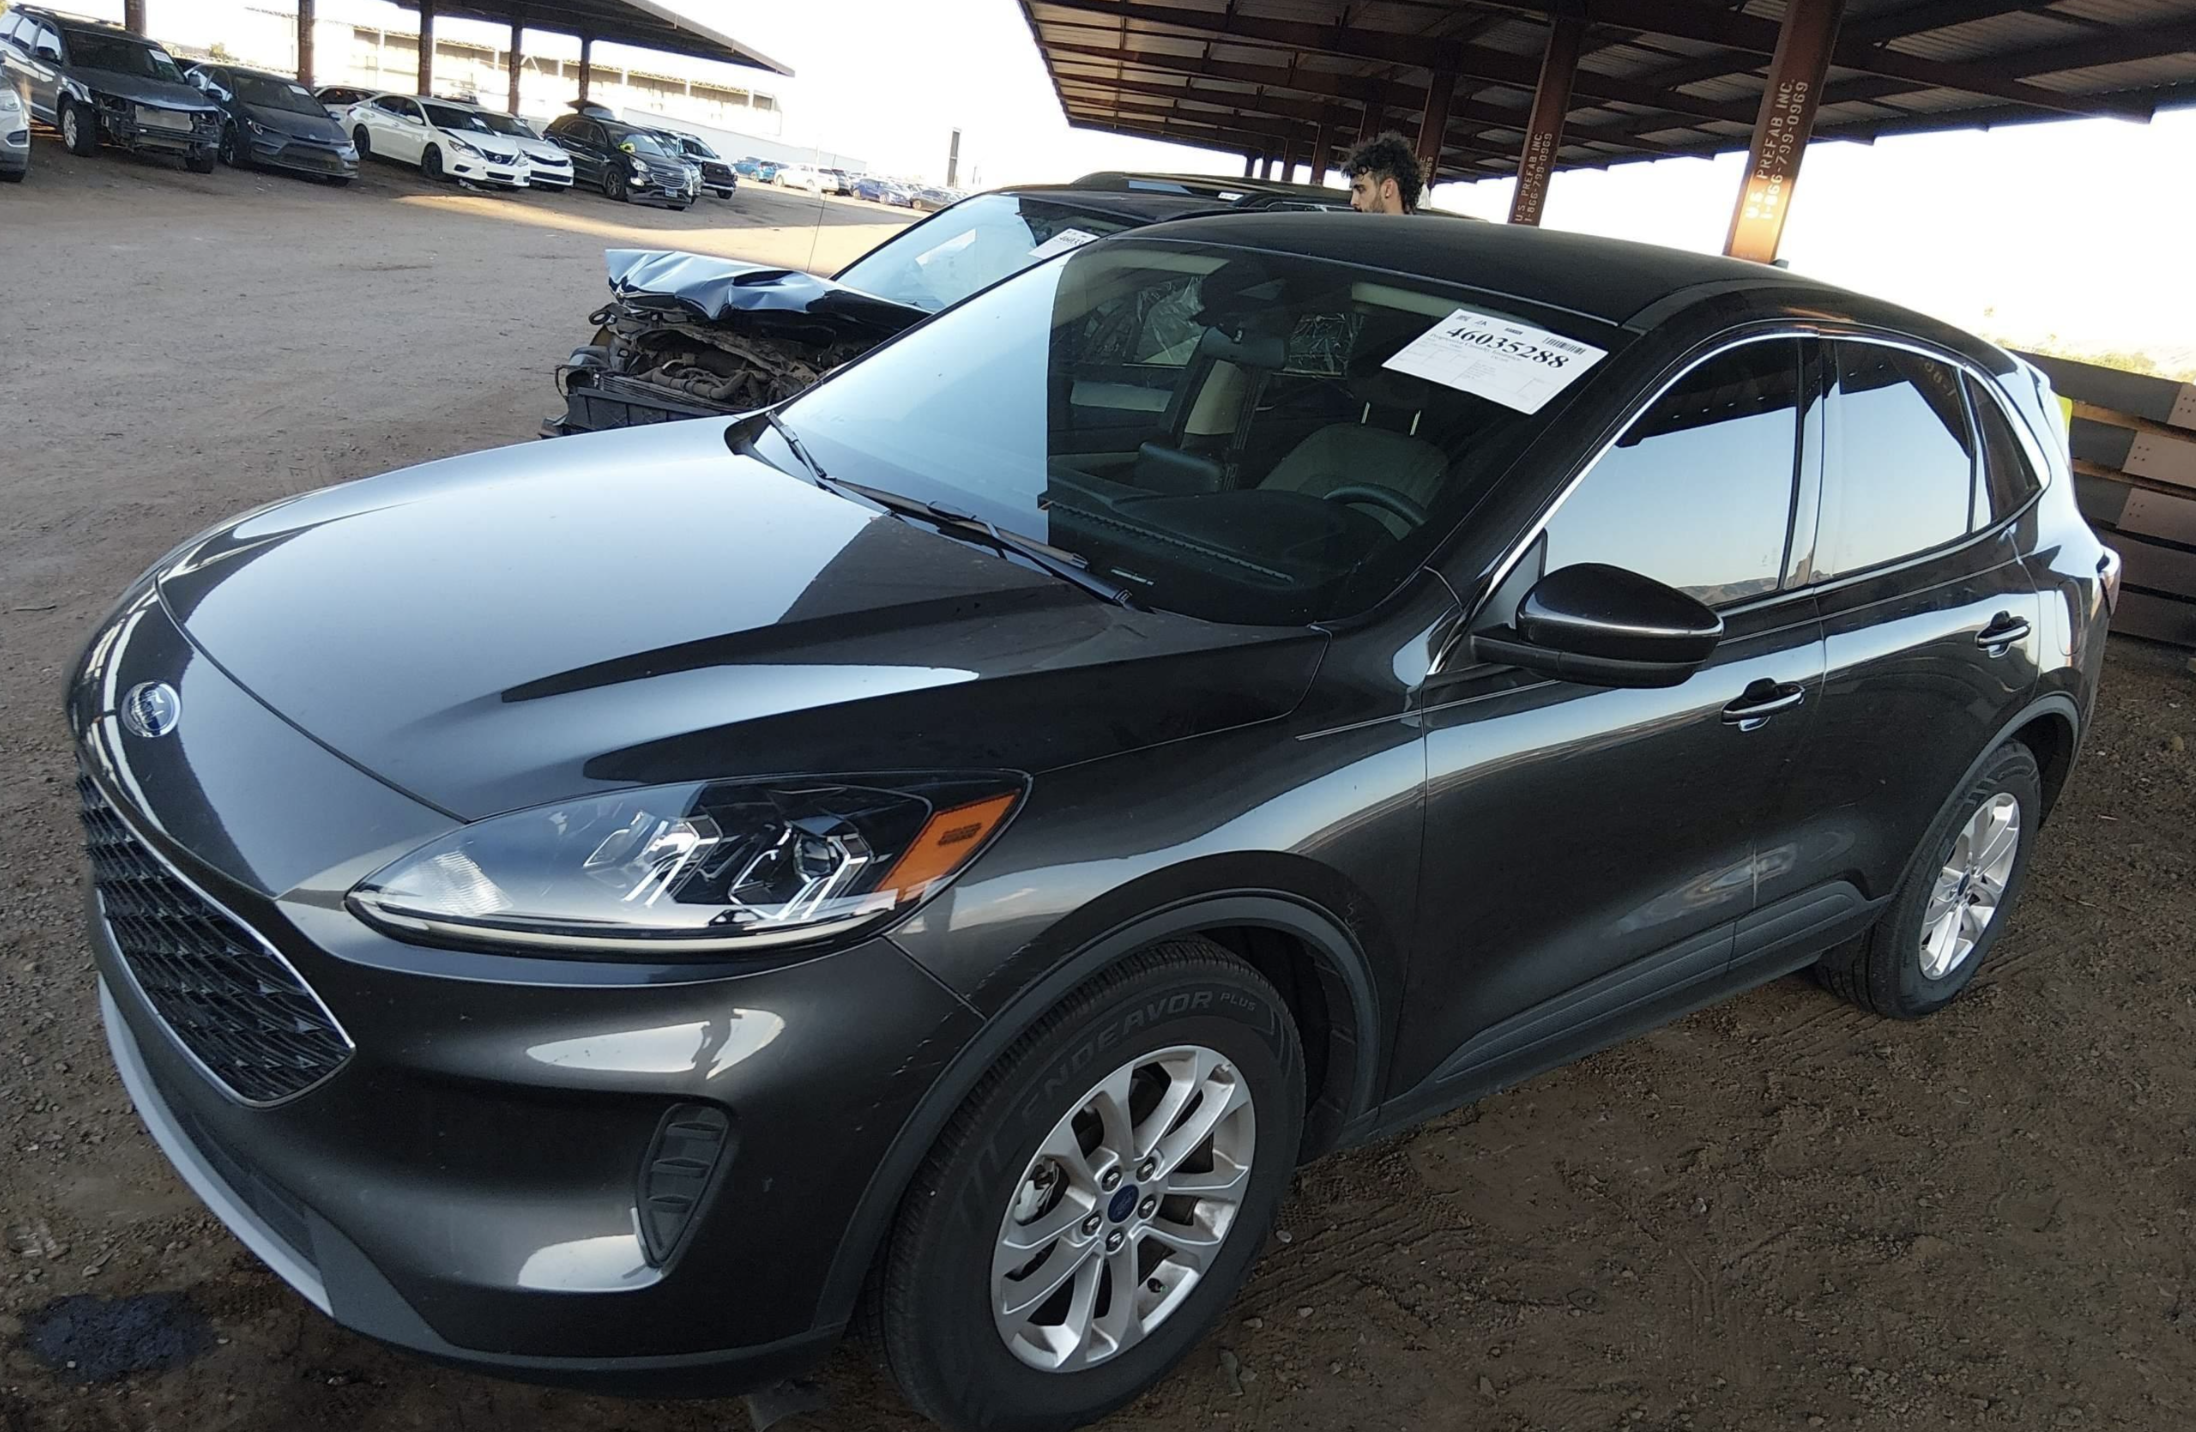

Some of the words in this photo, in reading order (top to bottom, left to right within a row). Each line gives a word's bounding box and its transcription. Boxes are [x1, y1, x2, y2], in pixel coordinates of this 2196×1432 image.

[1520, 155, 1537, 197] PREFAB
[1530, 131, 1544, 152] INC.
[1757, 116, 1784, 180] PREFAB
[1775, 78, 1796, 110] INC.
[1759, 81, 1809, 220] 1-866-799-0969
[1524, 133, 1553, 222] 1-866-799-0969
[1446, 327, 1569, 368] 46035288
[1021, 990, 1214, 1119] ENDEAVOR
[1219, 992, 1257, 1011] PLUS
